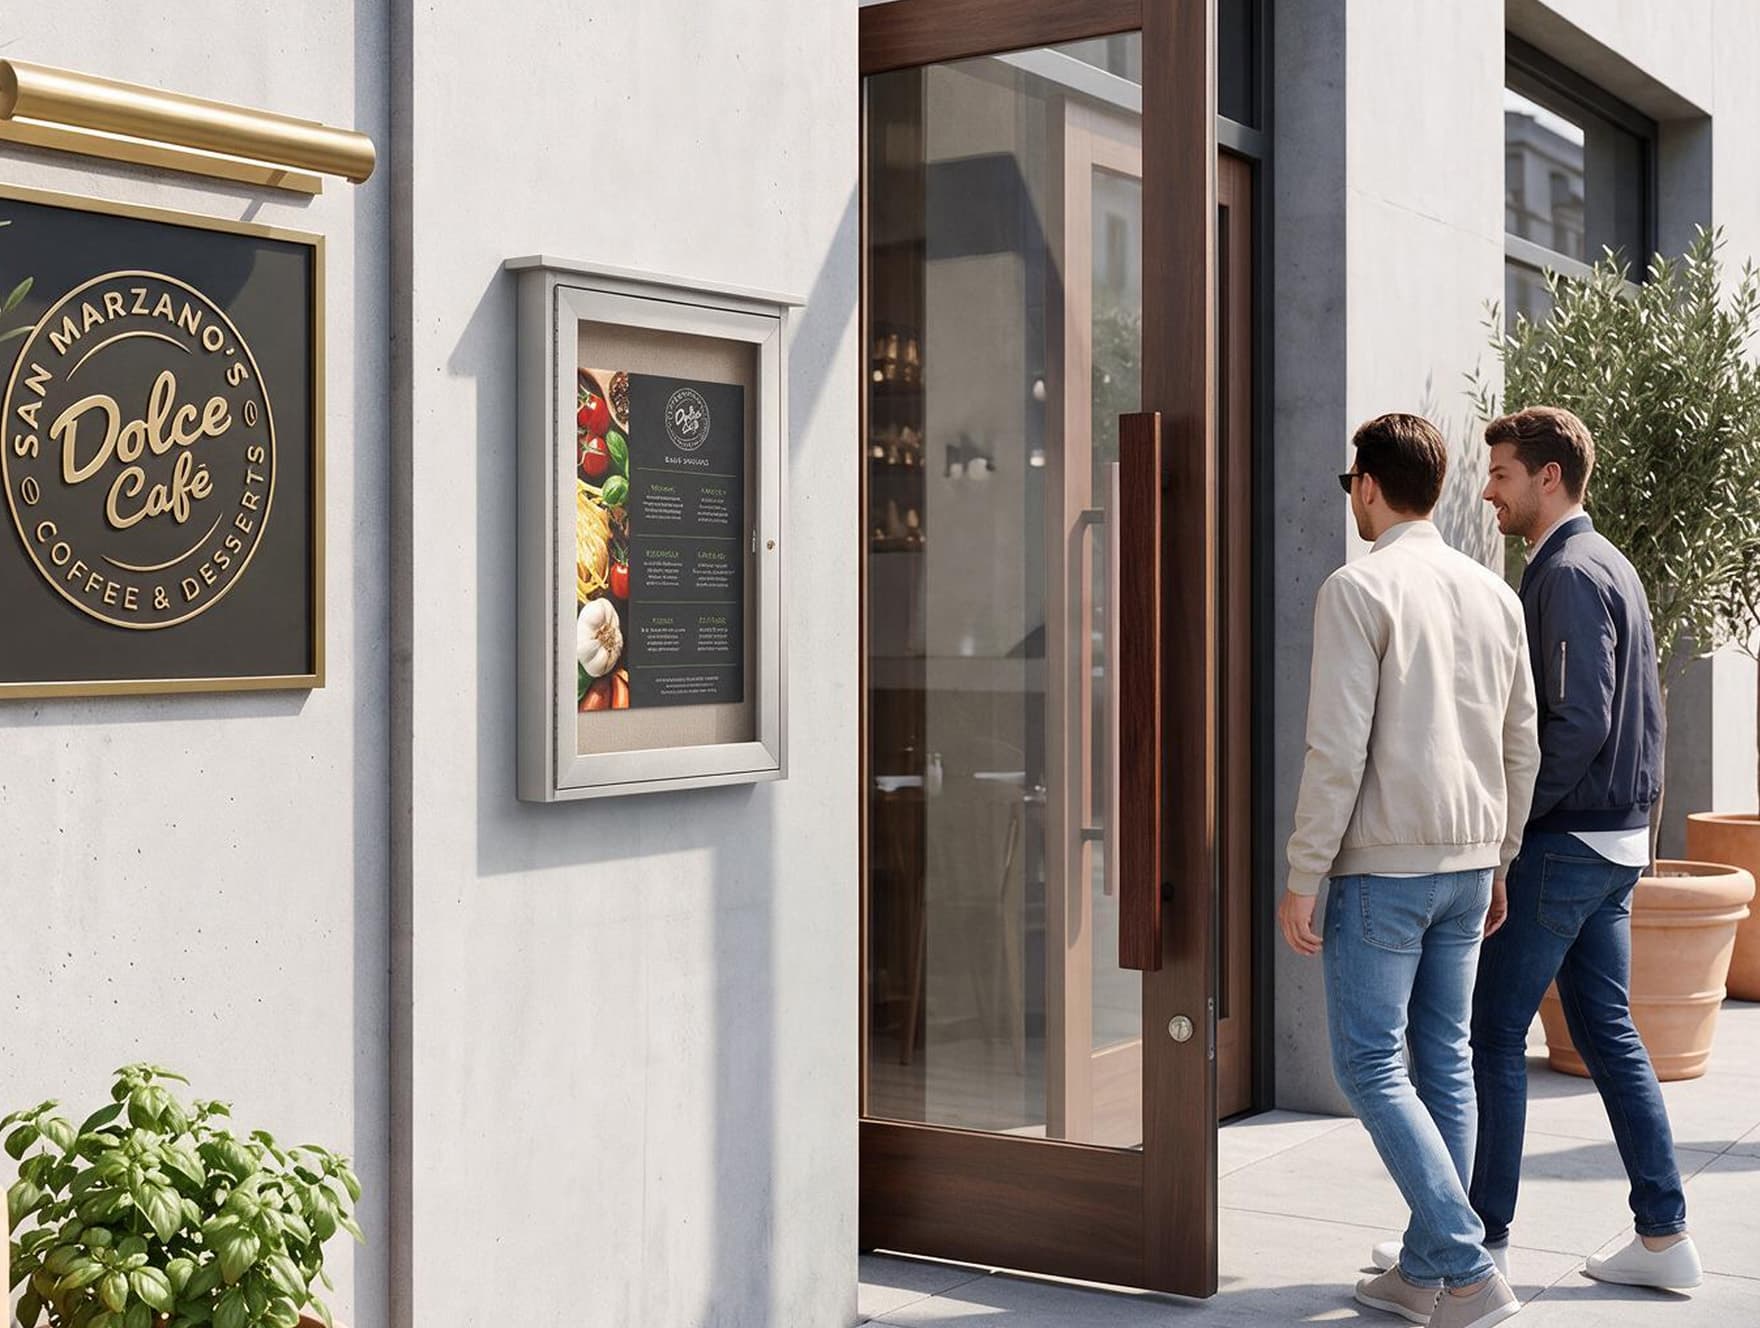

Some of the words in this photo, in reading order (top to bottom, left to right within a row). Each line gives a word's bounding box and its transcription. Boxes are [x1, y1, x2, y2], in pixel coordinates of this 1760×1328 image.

[15, 363, 53, 458] SAN
[48, 288, 249, 387] MARZANO'S
[49, 369, 232, 484] Dolce
[35, 520, 139, 610] COFFEE
[153, 586, 171, 610] &
[181, 445, 265, 601] DESSERTS
[106, 450, 213, 529] Café
